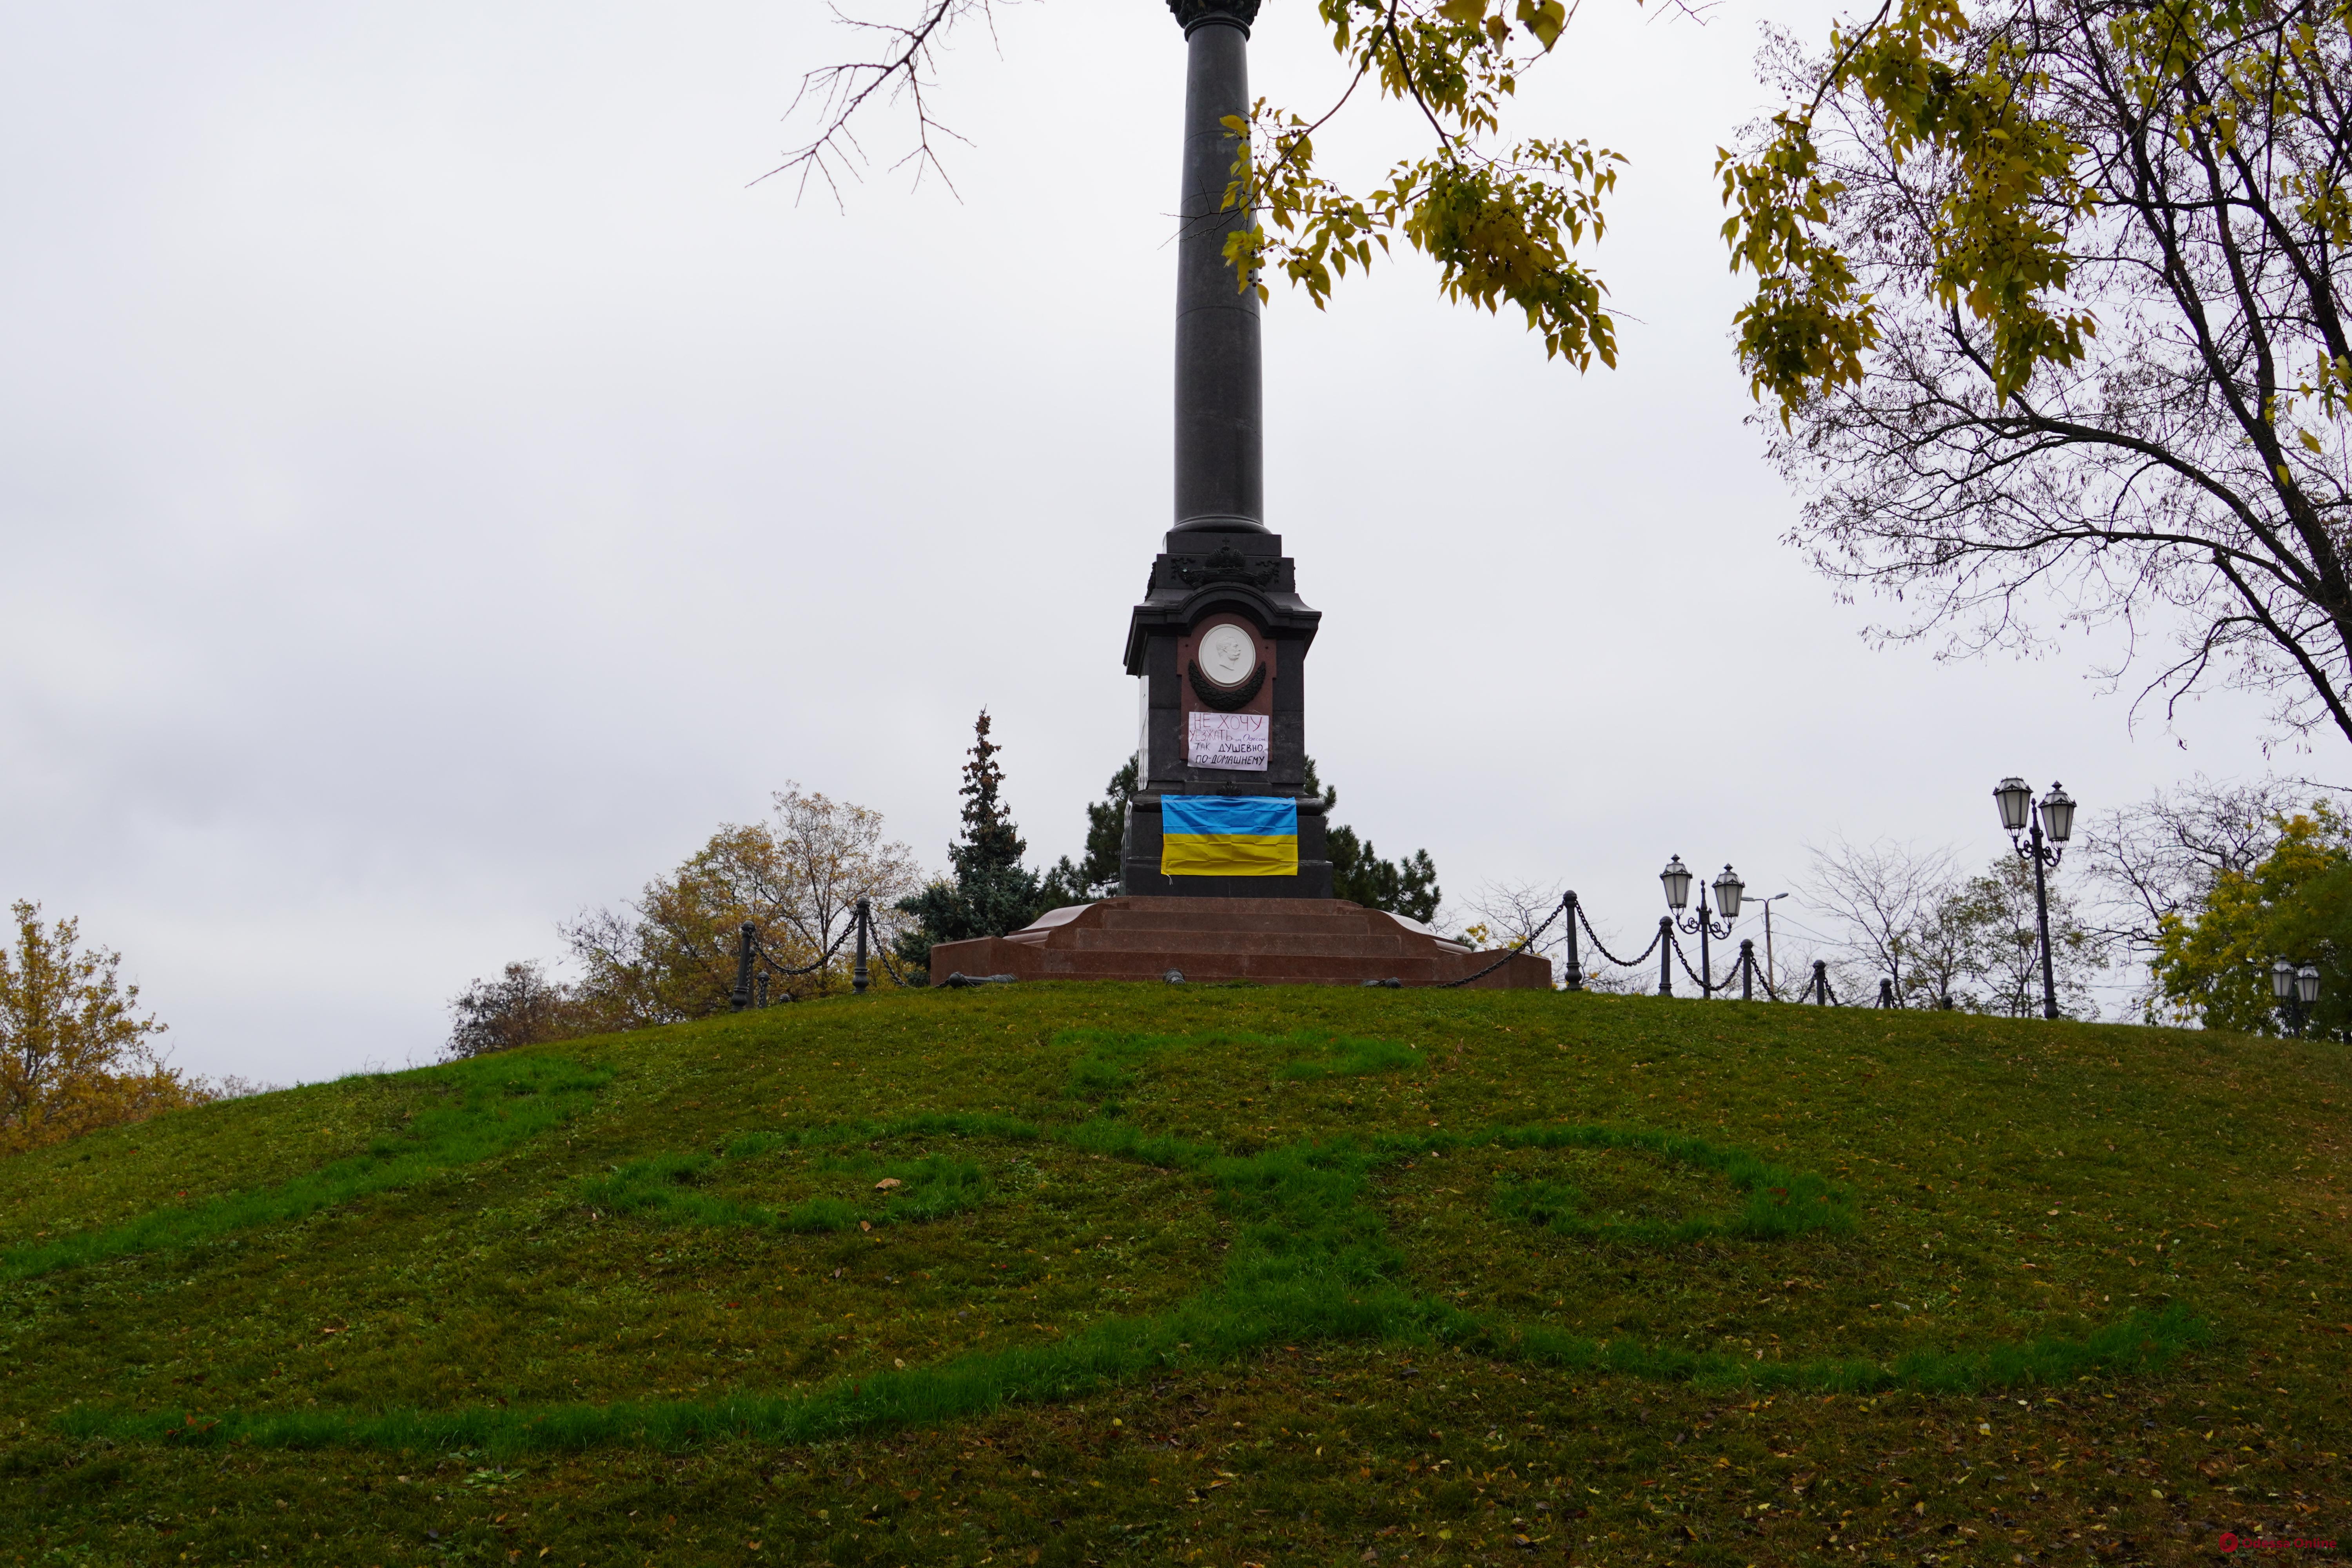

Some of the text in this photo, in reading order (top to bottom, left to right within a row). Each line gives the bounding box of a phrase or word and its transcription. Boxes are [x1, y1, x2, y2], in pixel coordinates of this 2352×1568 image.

[1194, 713, 1262, 731] НЕ ХОЧУ
[1189, 730, 1232, 741] УЕЗЖАТЬ
[1194, 742, 1210, 751] ТАК
[1196, 755, 1265, 766] ПО-ДОМАШНЕМУ
